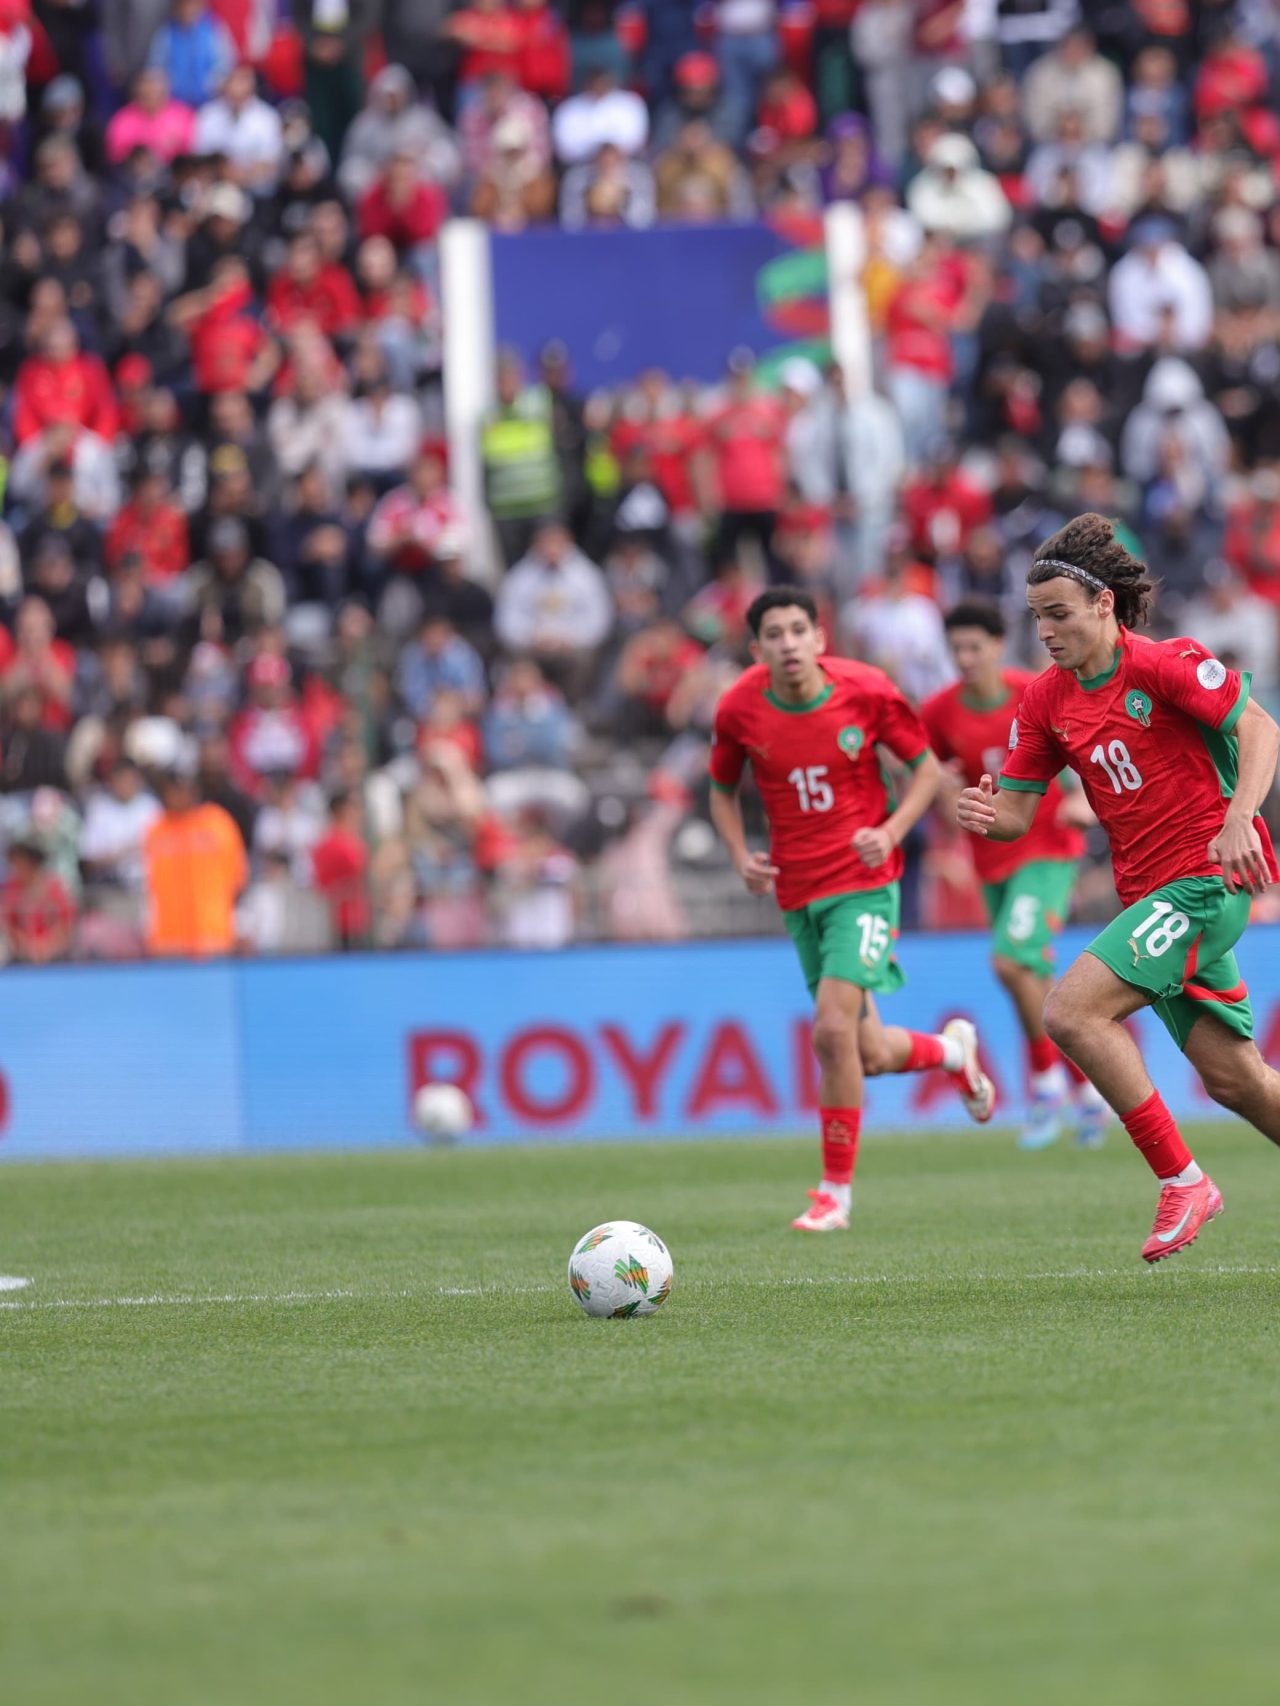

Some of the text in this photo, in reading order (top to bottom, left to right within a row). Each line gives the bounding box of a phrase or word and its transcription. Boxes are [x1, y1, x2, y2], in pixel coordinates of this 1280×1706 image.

[787, 765, 834, 812] 15
[1090, 739, 1143, 794] 18
[856, 913, 888, 961] 15
[1132, 901, 1190, 957] 18
